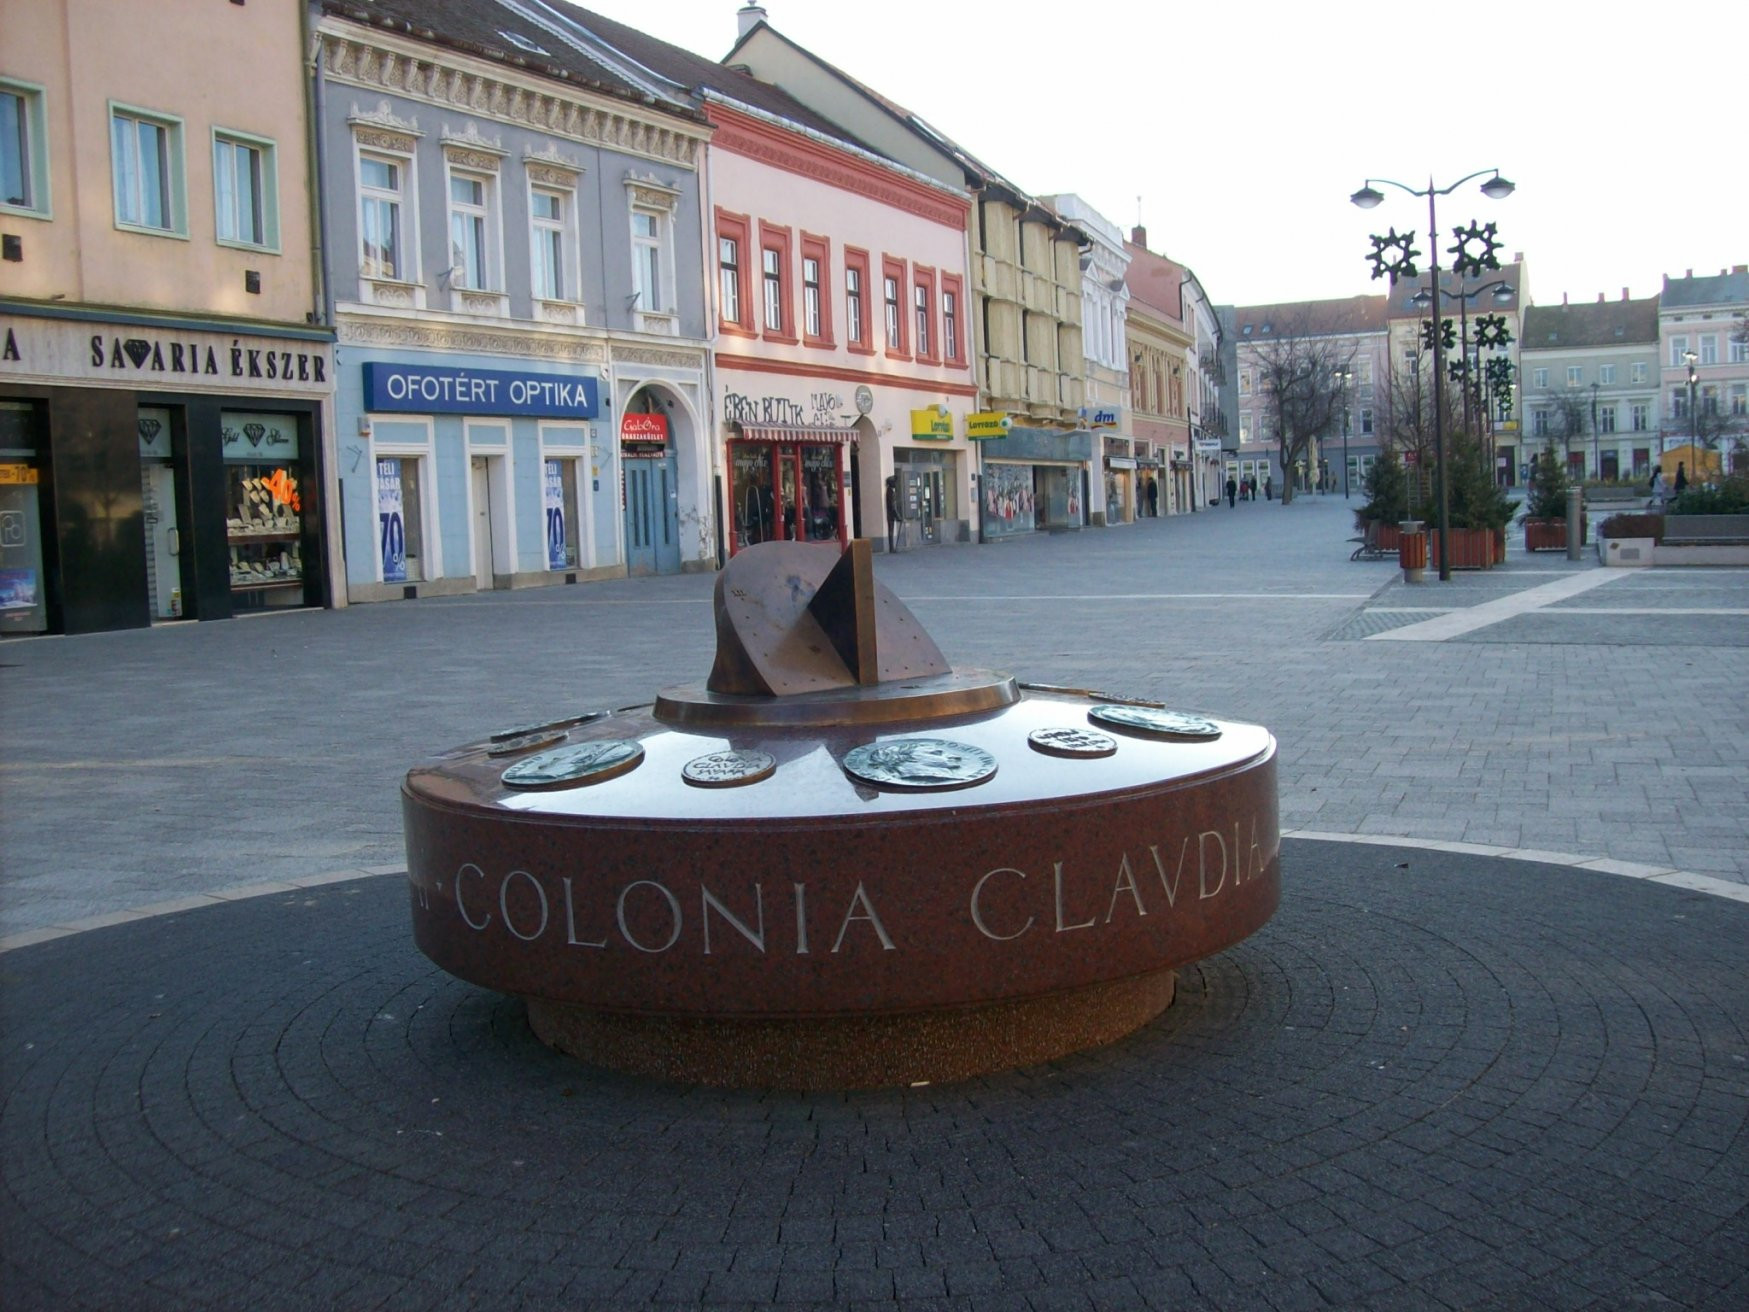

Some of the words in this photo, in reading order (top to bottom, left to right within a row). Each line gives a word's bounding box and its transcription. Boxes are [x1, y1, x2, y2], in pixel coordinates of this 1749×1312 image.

[230, 339, 326, 382] ÉKSZER
[387, 372, 500, 402] OFOTÉRT
[509, 380, 588, 408] OPTIKA
[1094, 410, 1115, 423] dm
[455, 862, 895, 954] COLONIA
[971, 816, 1265, 941] CLAVDIA
